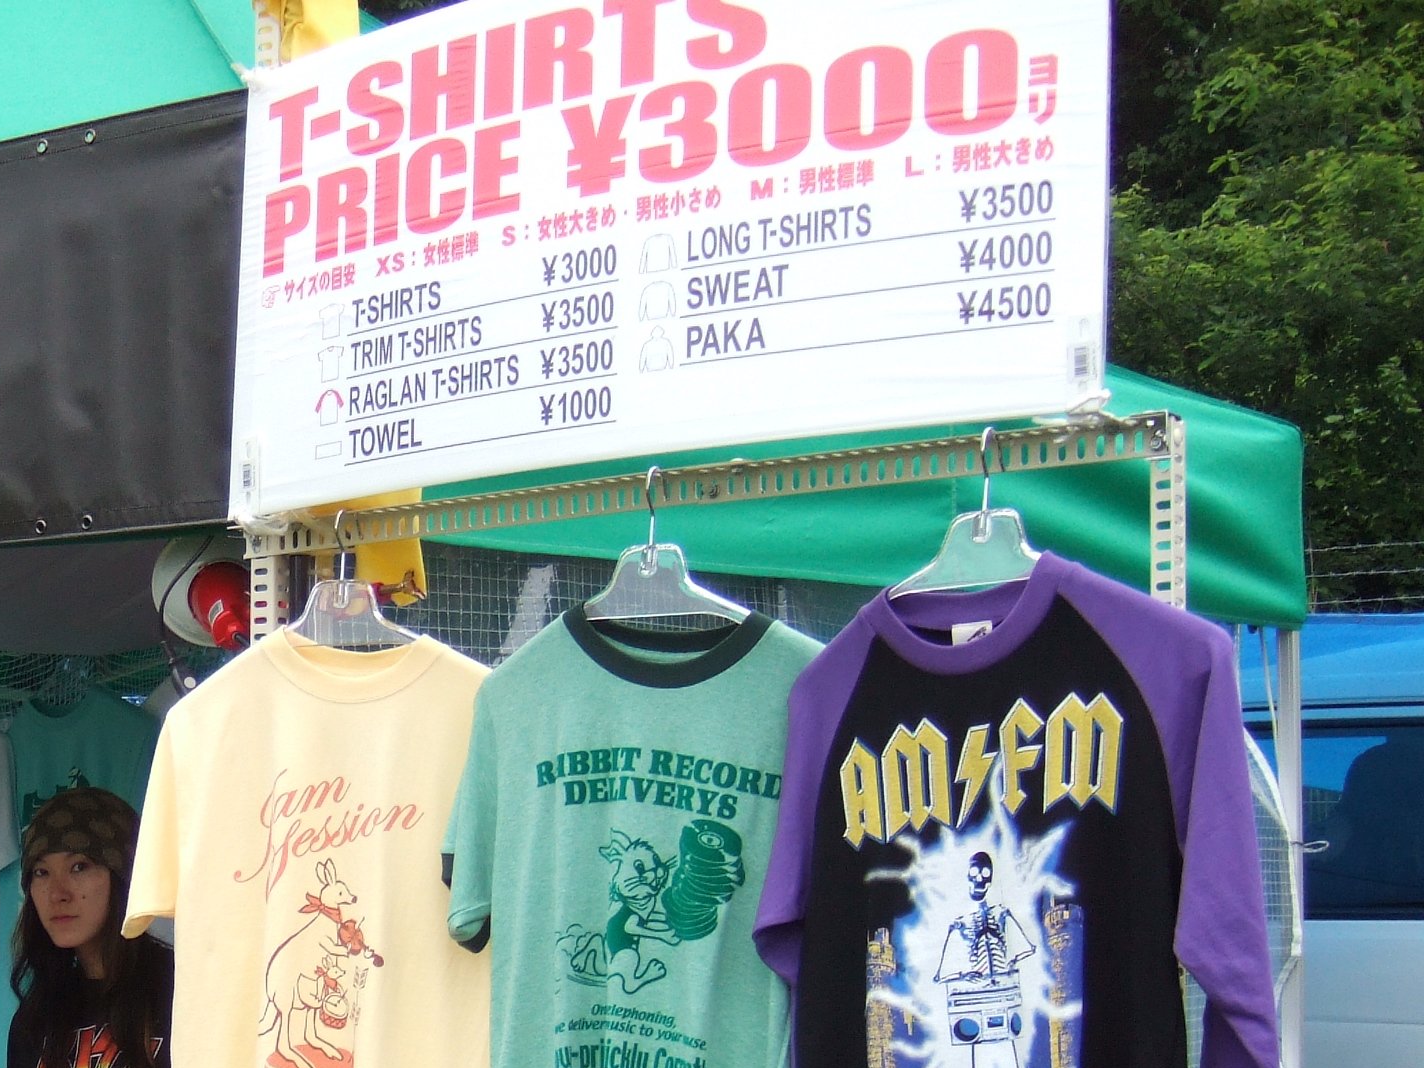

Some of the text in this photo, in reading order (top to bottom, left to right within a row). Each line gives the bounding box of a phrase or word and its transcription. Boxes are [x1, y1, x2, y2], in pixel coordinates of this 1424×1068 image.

[269, 0, 767, 182] T-SHIRTS
[1028, 53, 1059, 125] ヨリ
[263, 28, 1019, 278] PRICE ¥3000
[687, 180, 1053, 262] LONG T-SHIRTS ¥3500
[284, 263, 356, 303] サイズの目安
[352, 245, 617, 328] T-SHIRTS ¥3000
[687, 231, 1052, 310] SWEAT ¥4000
[351, 292, 615, 371] TRIM T-SHIRTS ¥3500
[686, 283, 1052, 358] PAKA ¥4500
[349, 338, 614, 416] RAGLAN T-SHIRTS ¥3500
[349, 386, 611, 458] TOWEL ¥1000
[536, 747, 641, 788] RIBBIT
[564, 777, 738, 820] DELIVERYS
[233, 768, 351, 883] Jam
[265, 802, 424, 902] Session
[640, 1024, 653, 1037] to
